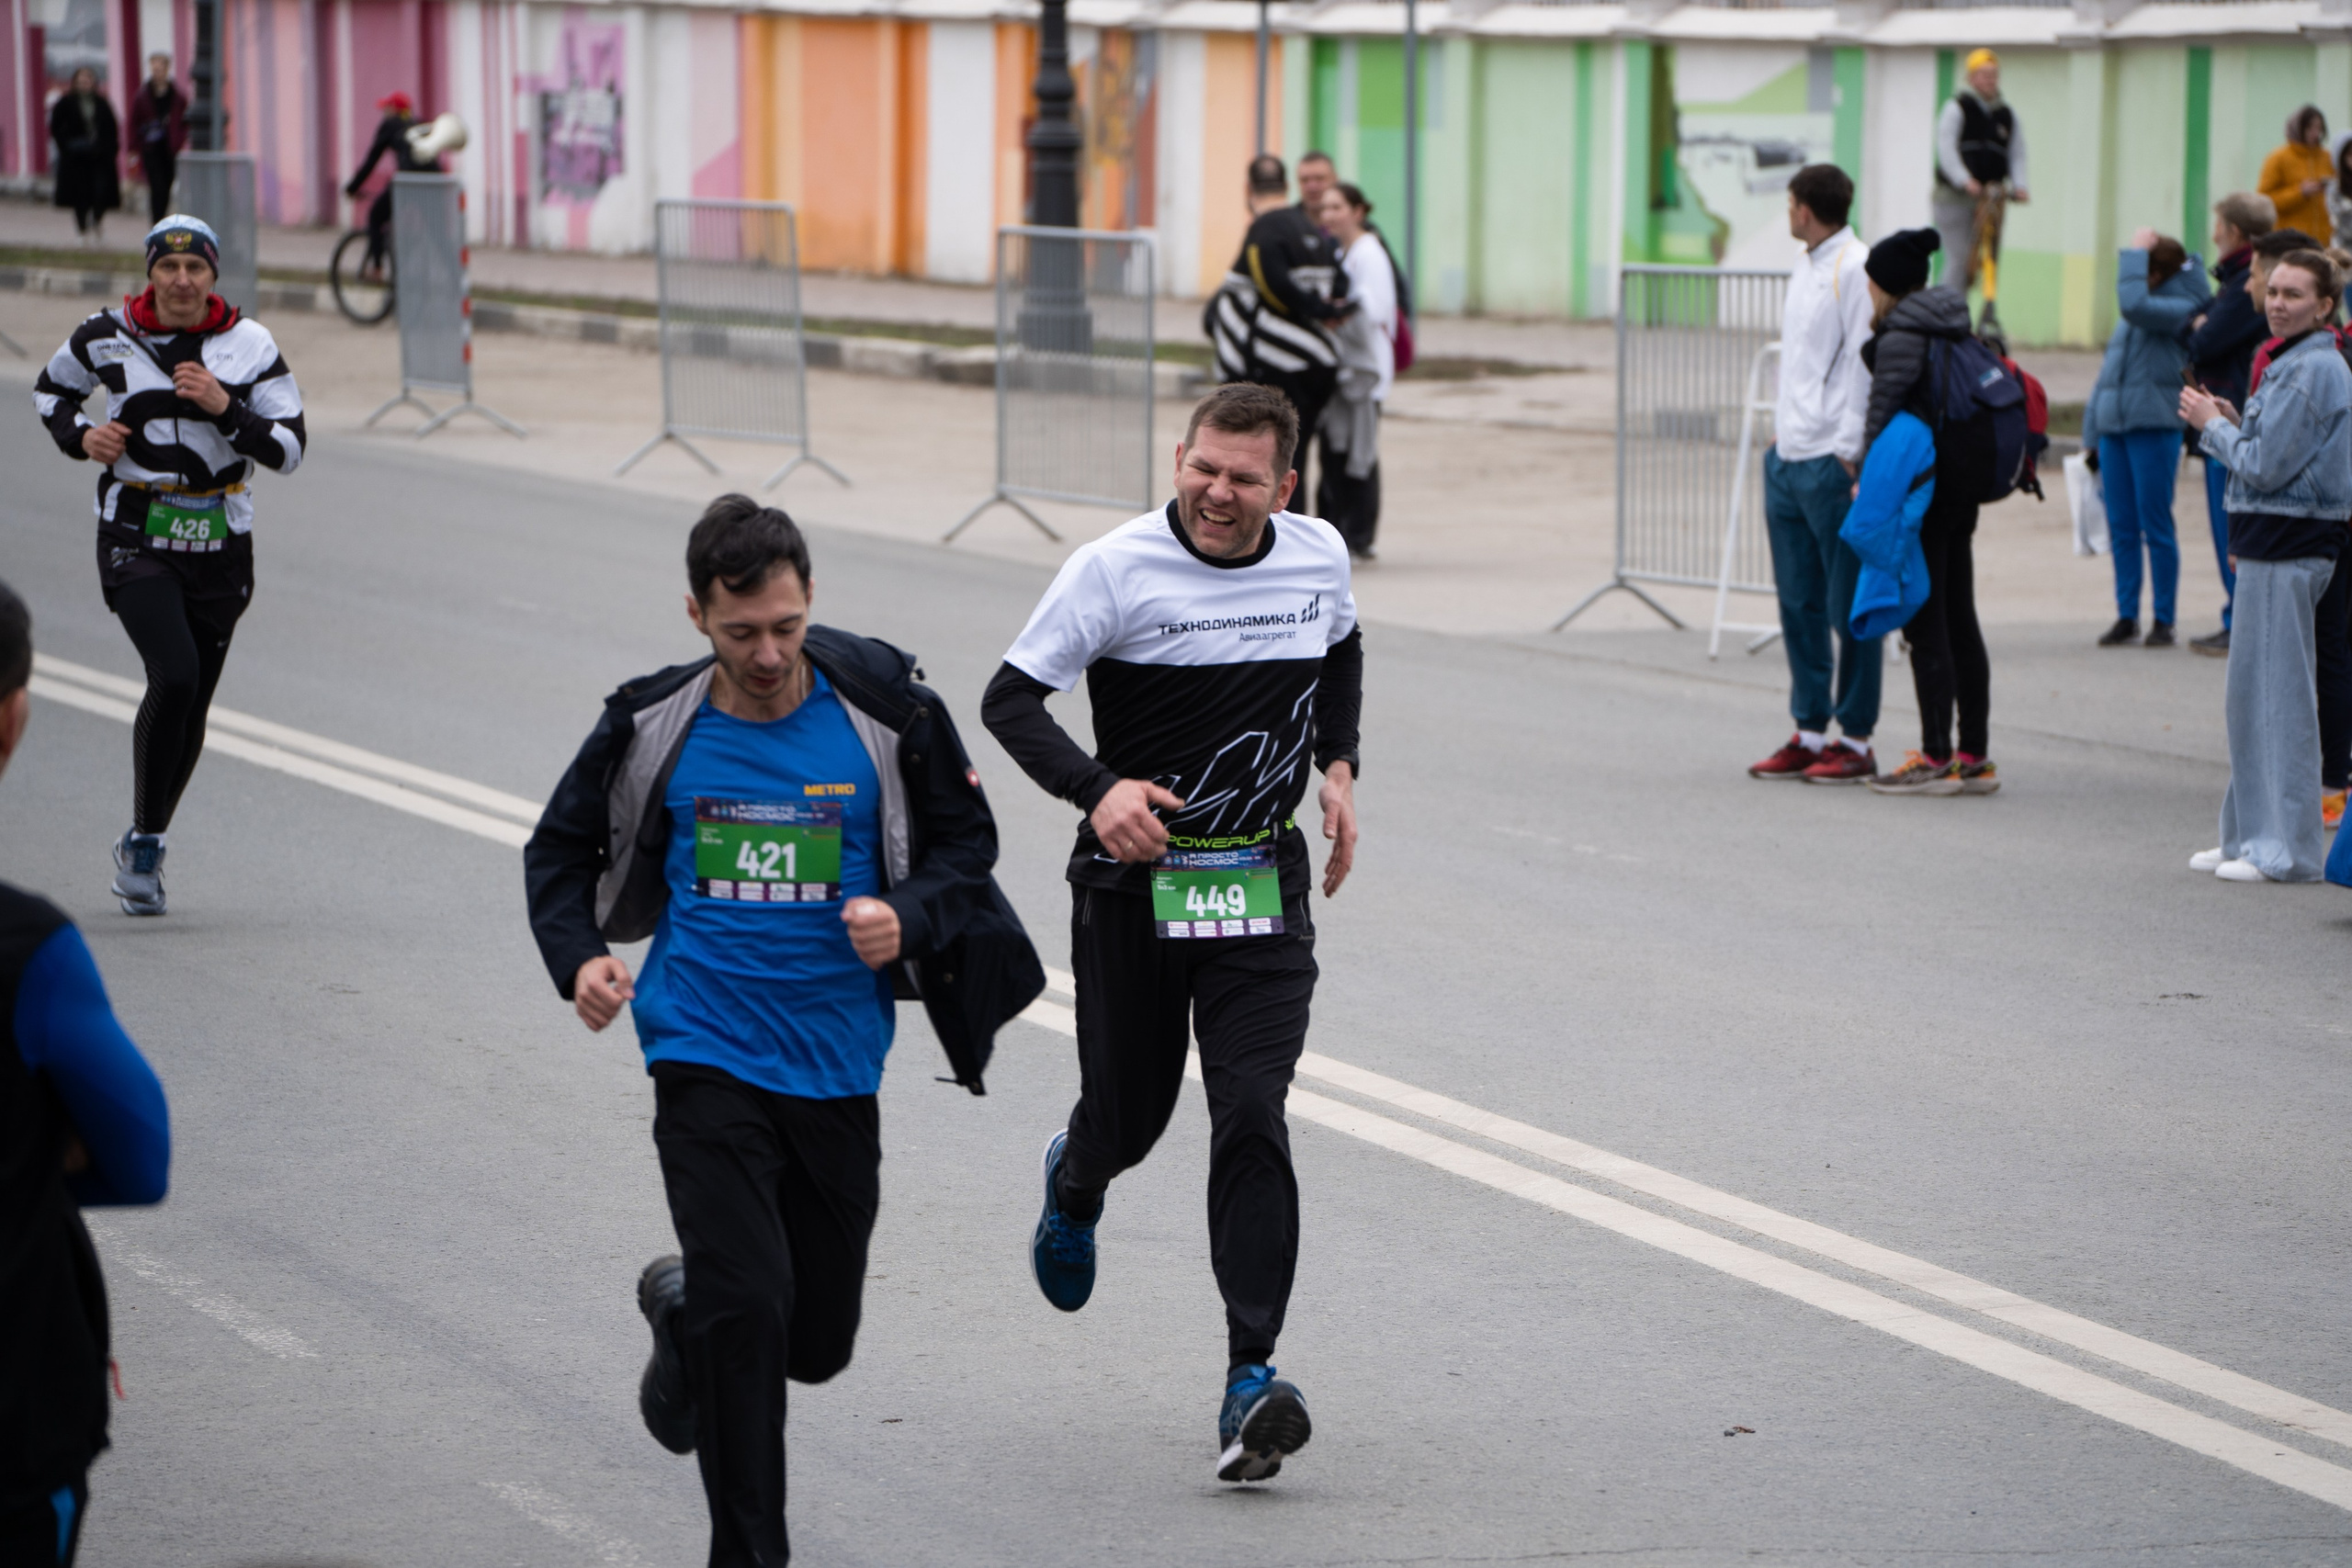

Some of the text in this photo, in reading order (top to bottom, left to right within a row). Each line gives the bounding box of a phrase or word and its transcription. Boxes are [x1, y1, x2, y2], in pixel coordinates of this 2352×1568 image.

[170, 517, 209, 540] 426
[1158, 614, 1296, 636] ТЕХНОДИНАМИКА
[1238, 631, 1296, 642] Авиаагрегат
[804, 784, 856, 796] METRO
[1167, 829, 1272, 849] POWERUP
[736, 840, 797, 879] 421
[1189, 858, 1239, 866] КОСМОС
[1185, 884, 1247, 918] 449
